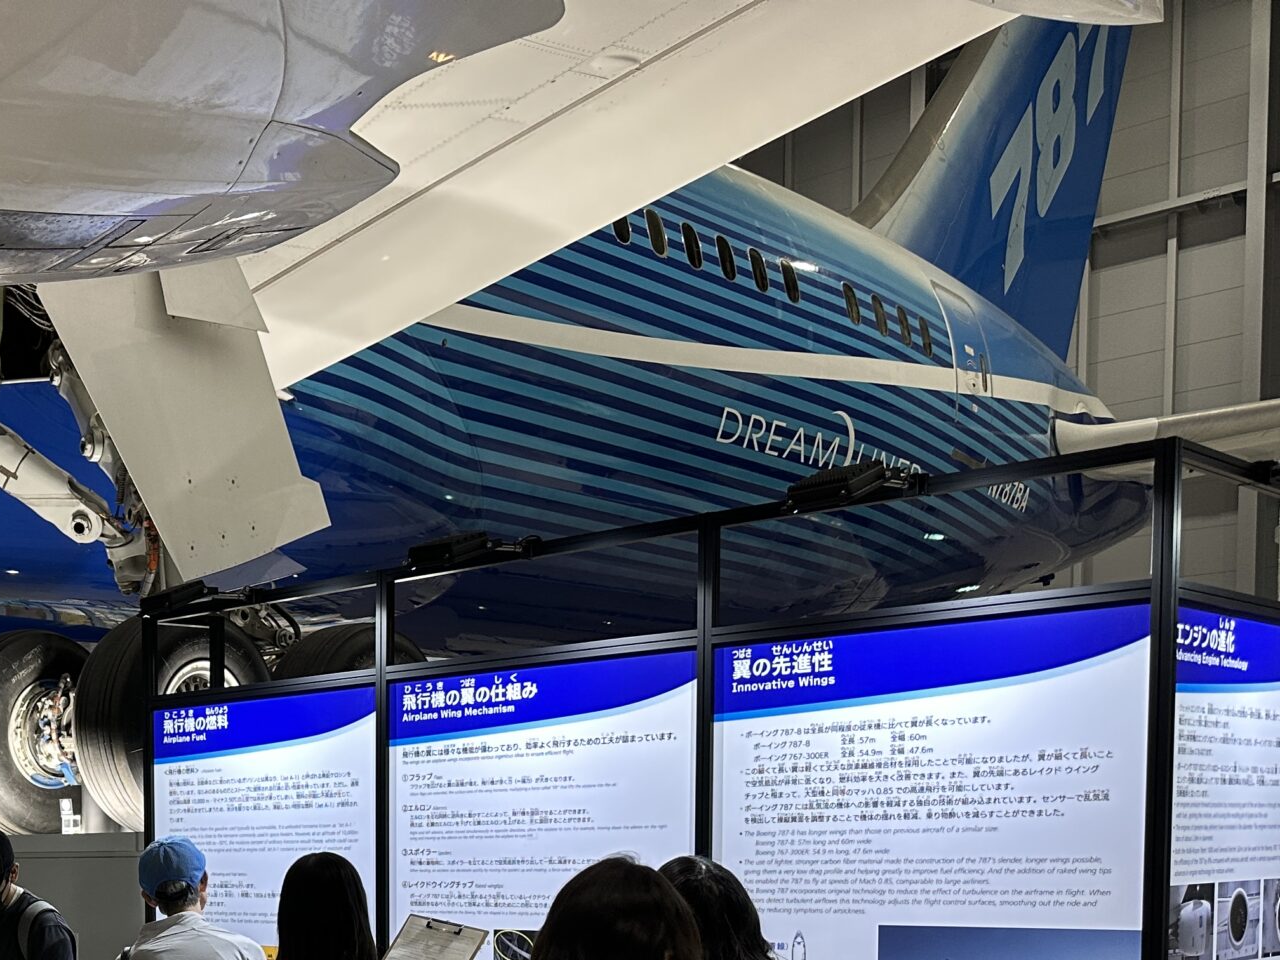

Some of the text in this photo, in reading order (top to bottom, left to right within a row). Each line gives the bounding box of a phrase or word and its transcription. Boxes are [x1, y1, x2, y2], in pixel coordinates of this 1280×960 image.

[1176, 623, 1236, 653] エンジンの進化
[732, 640, 834, 659] つばさ せんしんせい
[732, 652, 834, 679] 翼の先進性
[1202, 652, 1220, 667] Engine
[1220, 654, 1249, 672] Technology
[404, 681, 444, 694] ひこうき
[732, 674, 836, 693] Innovative Wings
[402, 682, 538, 711] 飛行機の翼の仕組み
[164, 709, 194, 720] ひこうき
[402, 704, 515, 723] Airplane Wing Mechanism
[163, 714, 229, 734] 飛行機の燃料
[163, 732, 207, 744] Airplane Fuel
